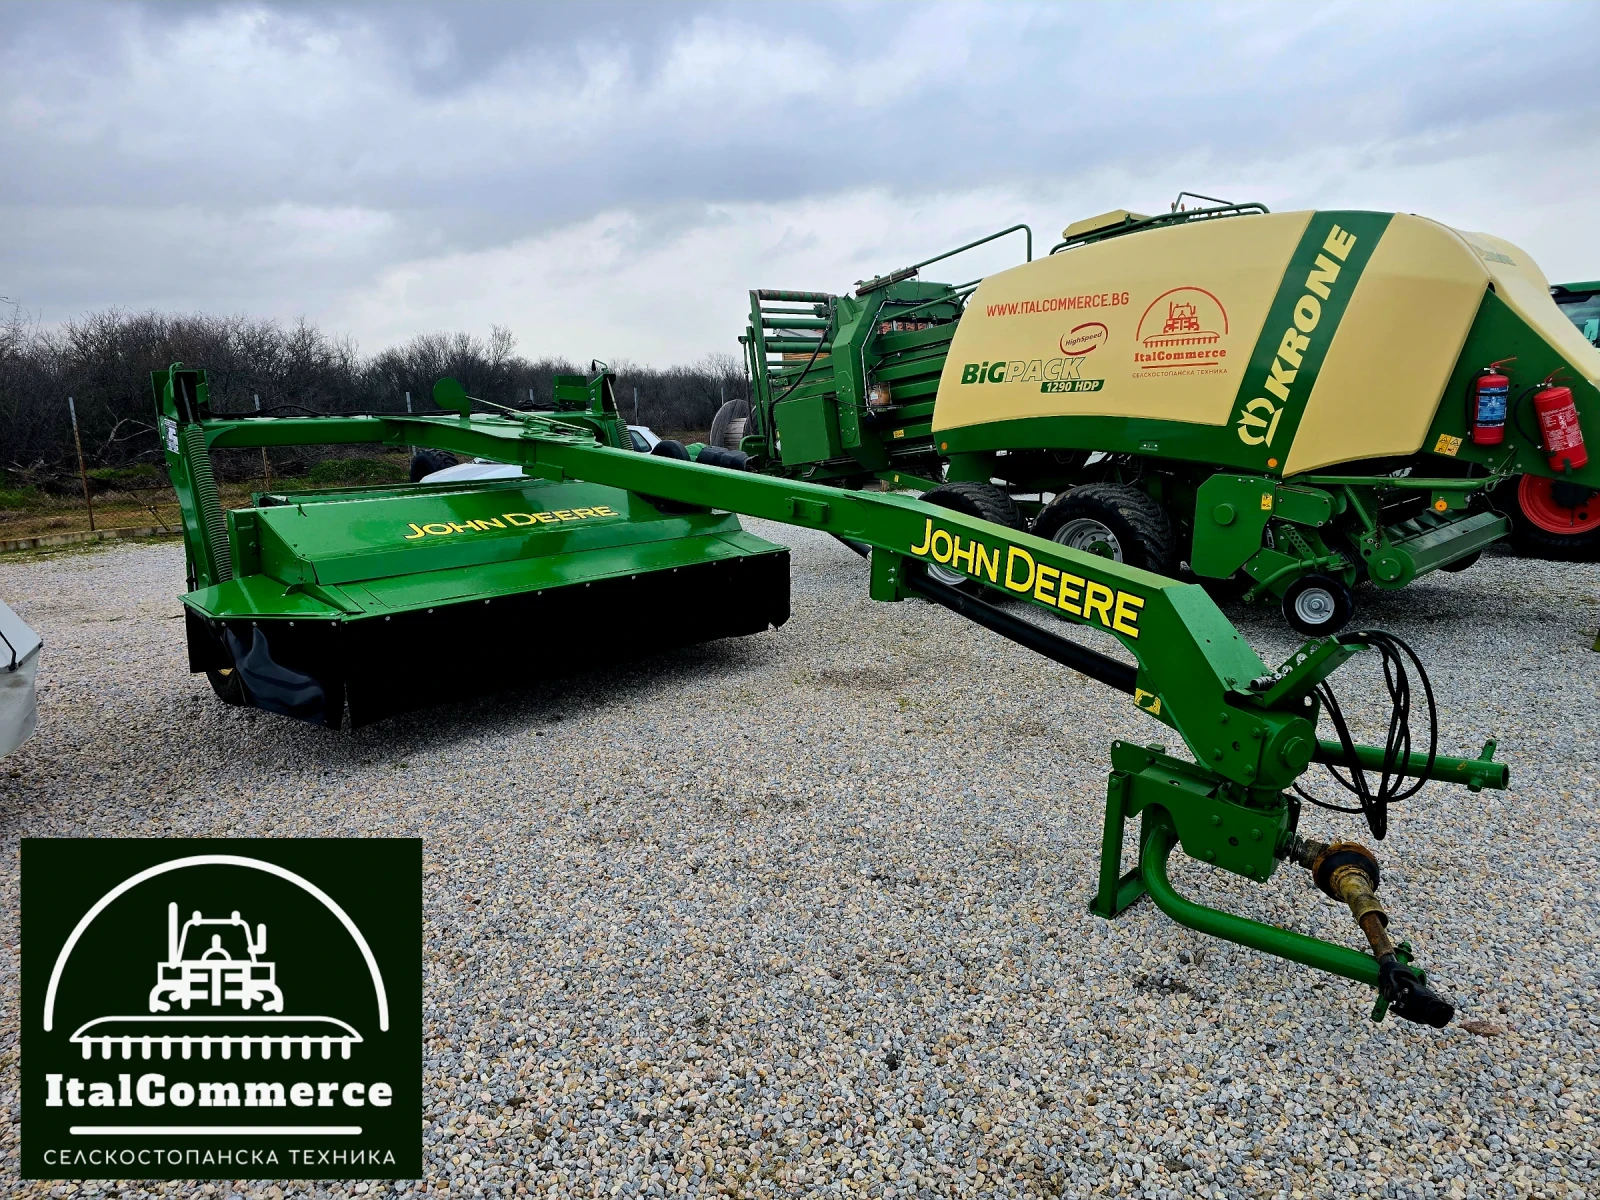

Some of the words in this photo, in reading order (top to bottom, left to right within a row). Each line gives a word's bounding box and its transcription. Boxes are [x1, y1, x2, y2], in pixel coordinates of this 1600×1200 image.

[986, 292, 1130, 317] WWW.ITALCOMMERCE.BG
[1264, 223, 1358, 402] KRONE
[1065, 331, 1103, 347] HighSpeed
[1134, 349, 1227, 363] ItalCommerce
[1132, 370, 1195, 379] СЕЛСКОСТОПАНСКА
[1196, 368, 1229, 376] ТЕХНИКА
[1046, 382, 1072, 393] 1290
[1074, 381, 1101, 392] HDP
[404, 517, 508, 540] JOHN
[501, 505, 620, 527] DEERE
[910, 517, 1000, 584] JOHN
[1004, 544, 1146, 640] DEERE
